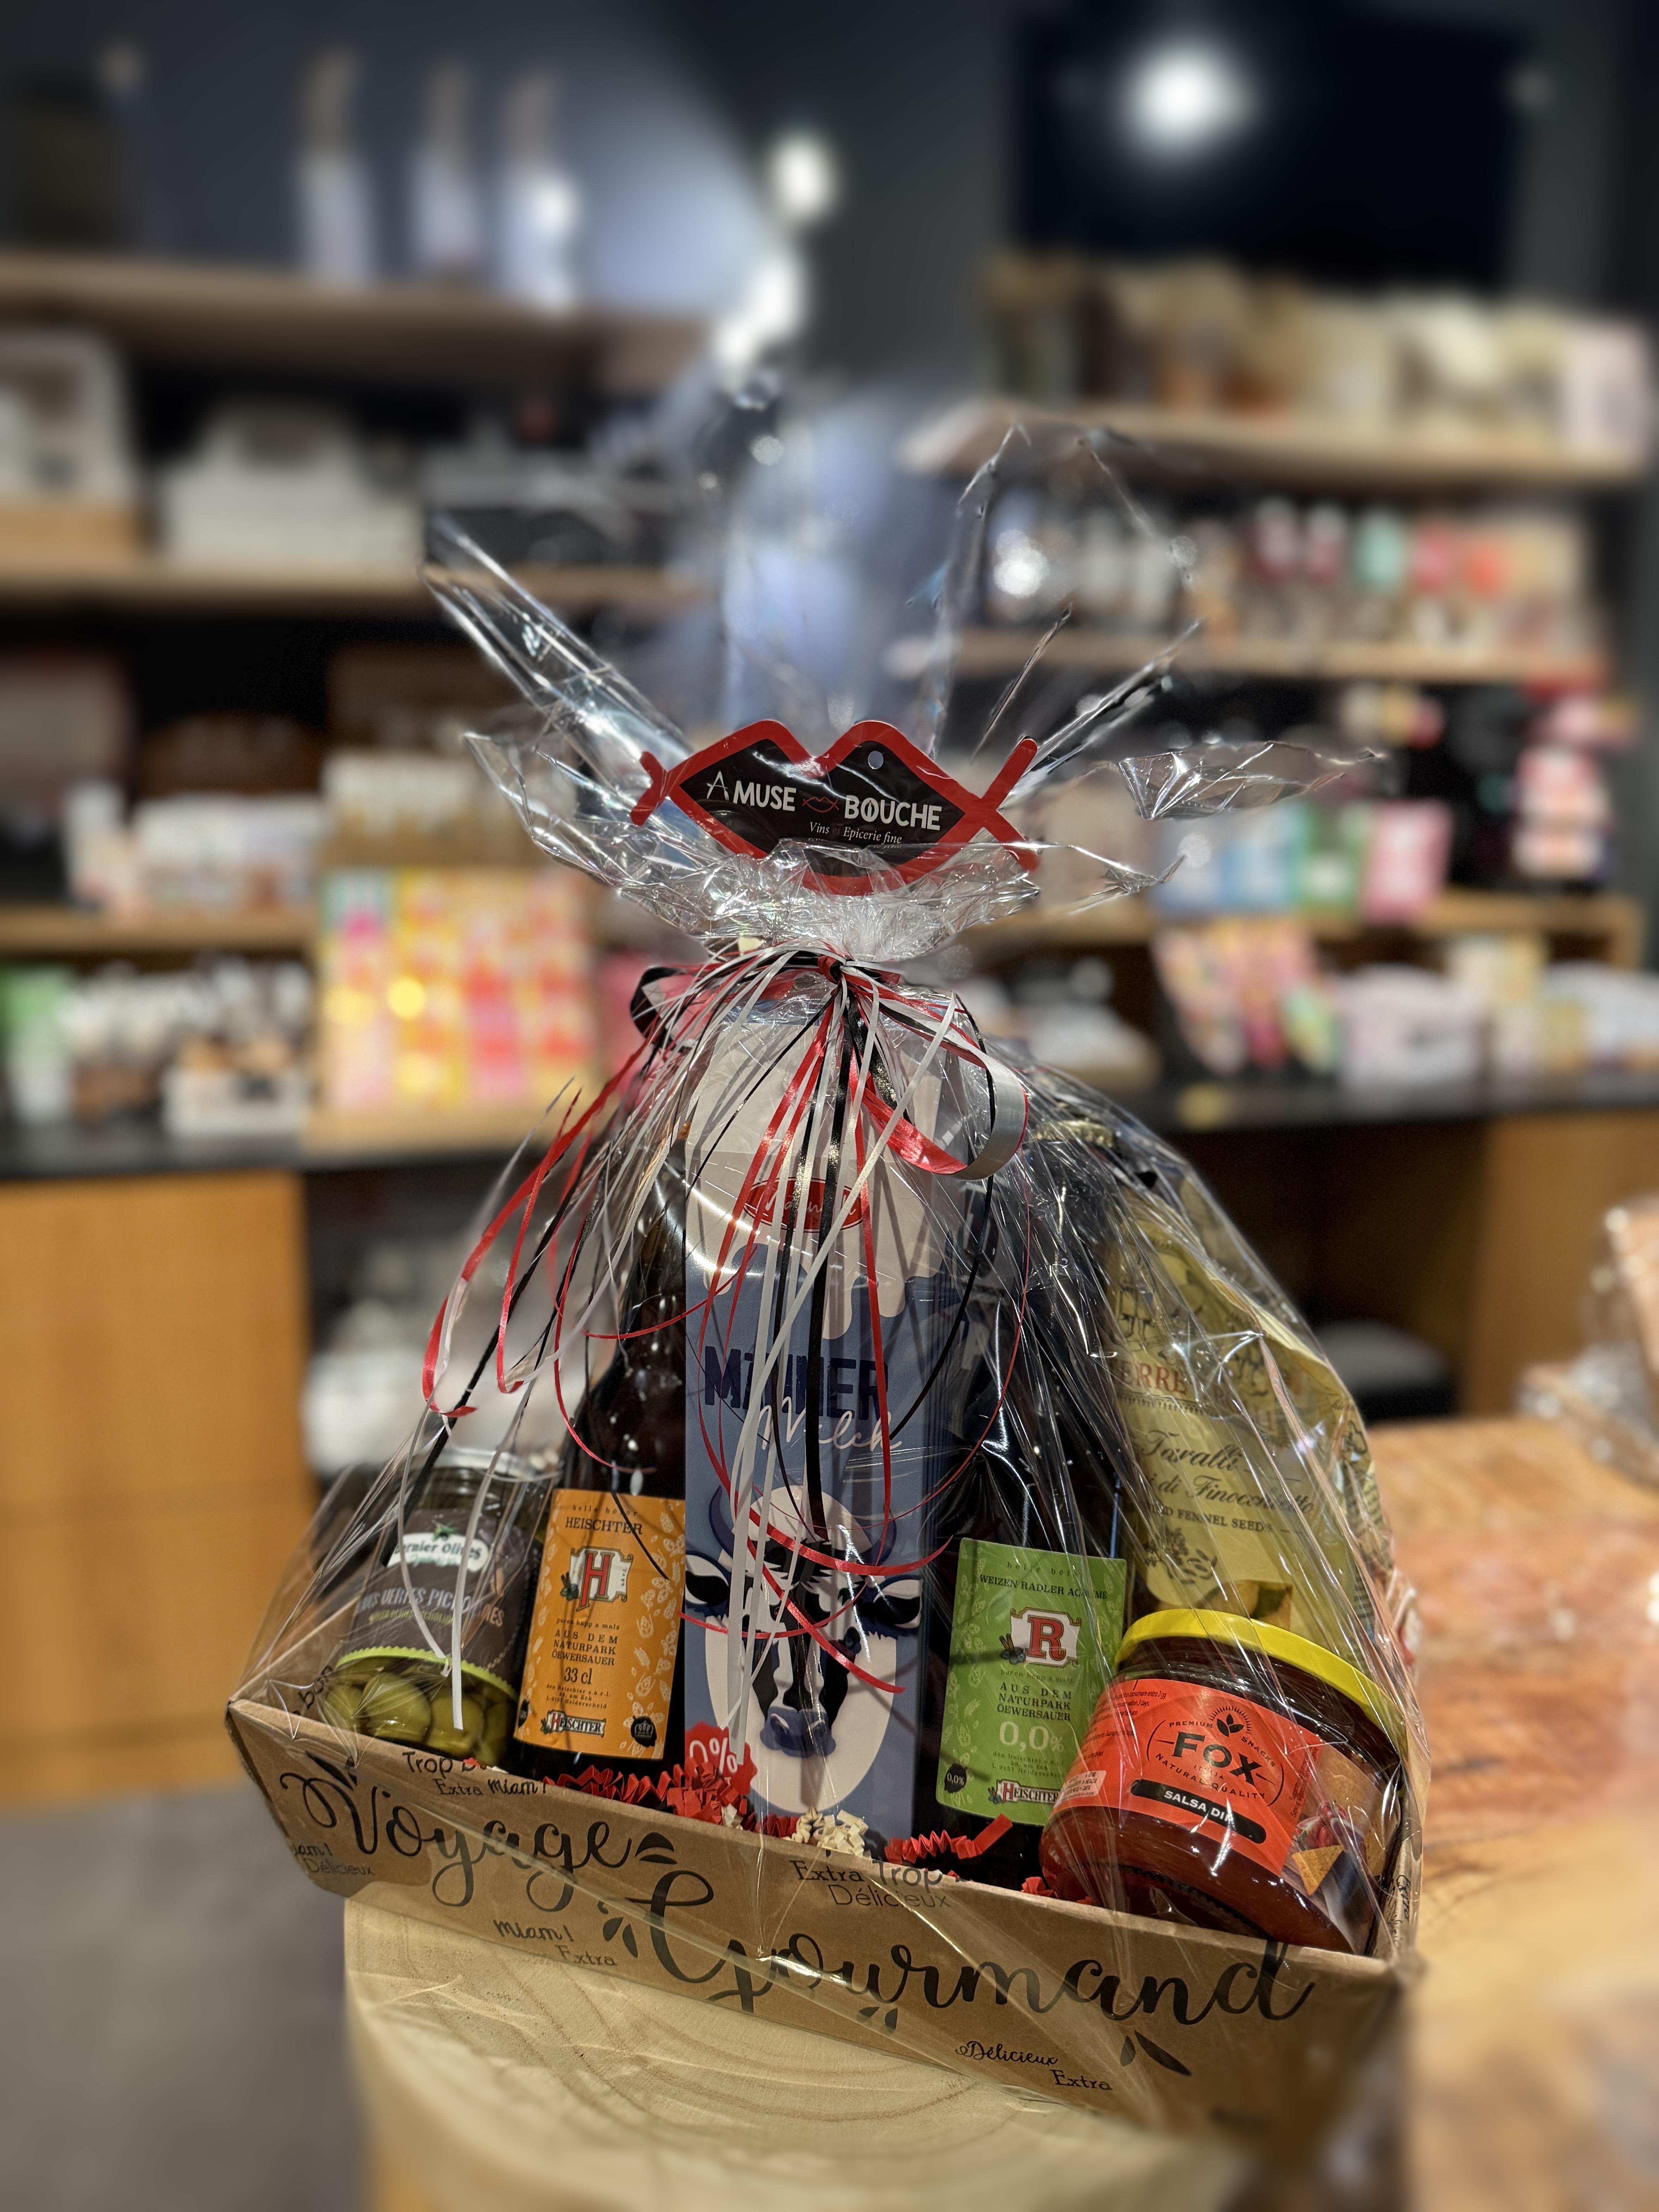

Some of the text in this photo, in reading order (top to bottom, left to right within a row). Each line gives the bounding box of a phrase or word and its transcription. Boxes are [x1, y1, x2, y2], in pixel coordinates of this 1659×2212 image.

[706, 771, 942, 831] AMUSE BOUCHE
[810, 821, 830, 834] Vins
[843, 827, 881, 841] Epicerie
[881, 831, 902, 845] fine
[565, 1516, 643, 1535] HEISCHTER
[1177, 1508, 1228, 1527] FENNEL
[1231, 1518, 1272, 1532] SEEDS
[980, 1574, 1018, 1588] WEIZEN
[1021, 1581, 1064, 1595] RADLER
[553, 1639, 616, 1655] NATURPARK
[555, 1629, 618, 1644] AUS DEM
[1025, 1615, 1066, 1661] R
[564, 1667, 592, 1685] 33 cl
[999, 1692, 1070, 1710] NATURPARK
[1000, 1682, 1072, 1699] AUS DEM
[551, 1712, 601, 1733] HEISCHTER
[997, 1702, 1070, 1721] ÖEWERSAUER
[1169, 1721, 1276, 1767] PREMIUM SNACKS
[402, 1751, 453, 1779] Trop
[1171, 1731, 1263, 1787] FOX
[433, 1778, 483, 1795] Extra
[947, 1773, 965, 1786] 0,0%
[1212, 1782, 1266, 1799] QUALITY
[1003, 1782, 1059, 1803] HEISCHTER
[1164, 1791, 1234, 1822] SALSA DIP
[280, 1772, 632, 1913] Voyage
[789, 1858, 943, 1893] Extra Trop
[828, 1884, 951, 1908] Délicieux
[554, 1944, 618, 1966] Extra
[625, 1870, 1315, 2025] Gourmand
[955, 2040, 1059, 2066] Délicieux
[1049, 2069, 1113, 2091] Extra
